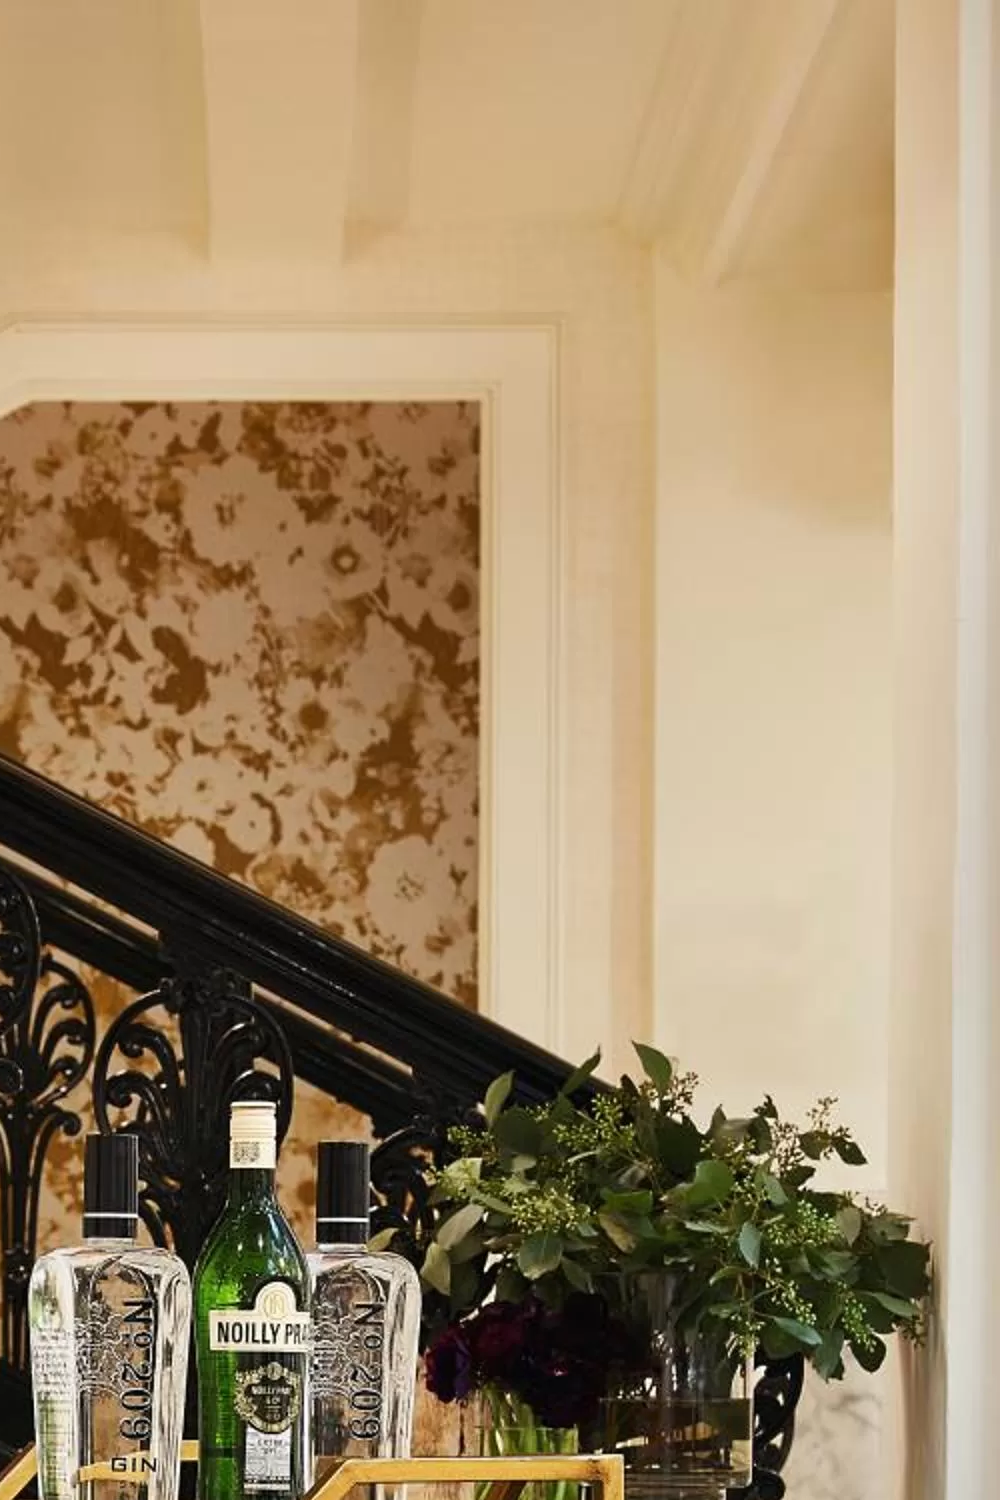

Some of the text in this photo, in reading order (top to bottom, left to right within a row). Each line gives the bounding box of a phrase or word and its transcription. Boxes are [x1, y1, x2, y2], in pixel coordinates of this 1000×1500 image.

[217, 1321, 281, 1344] NOILLY
[119, 1363, 154, 1441] 209
[350, 1363, 382, 1439] 209
[111, 1457, 158, 1473] GIN
